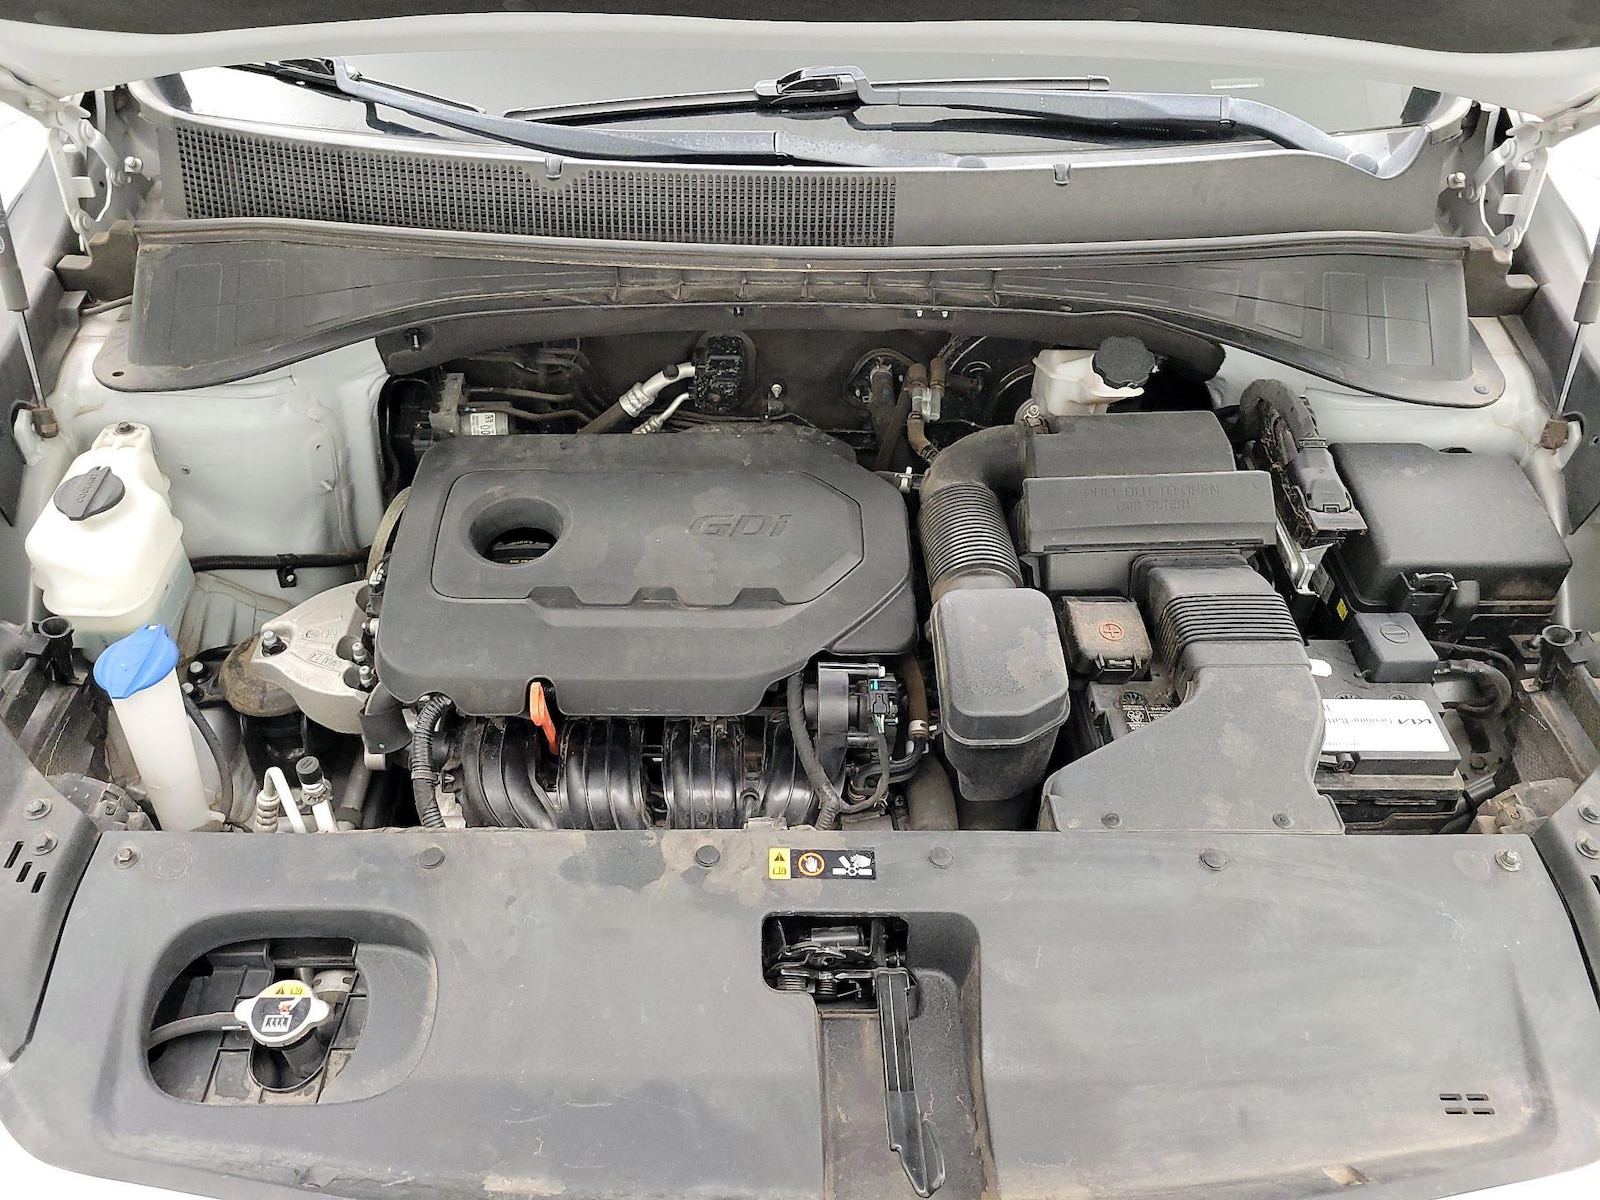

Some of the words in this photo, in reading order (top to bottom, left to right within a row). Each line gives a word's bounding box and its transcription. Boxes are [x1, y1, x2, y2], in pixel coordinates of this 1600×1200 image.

[1085, 486, 1118, 499] PULL
[1124, 486, 1151, 498] OUT
[1160, 485, 1176, 497] TO
[1180, 483, 1219, 497] OPEN
